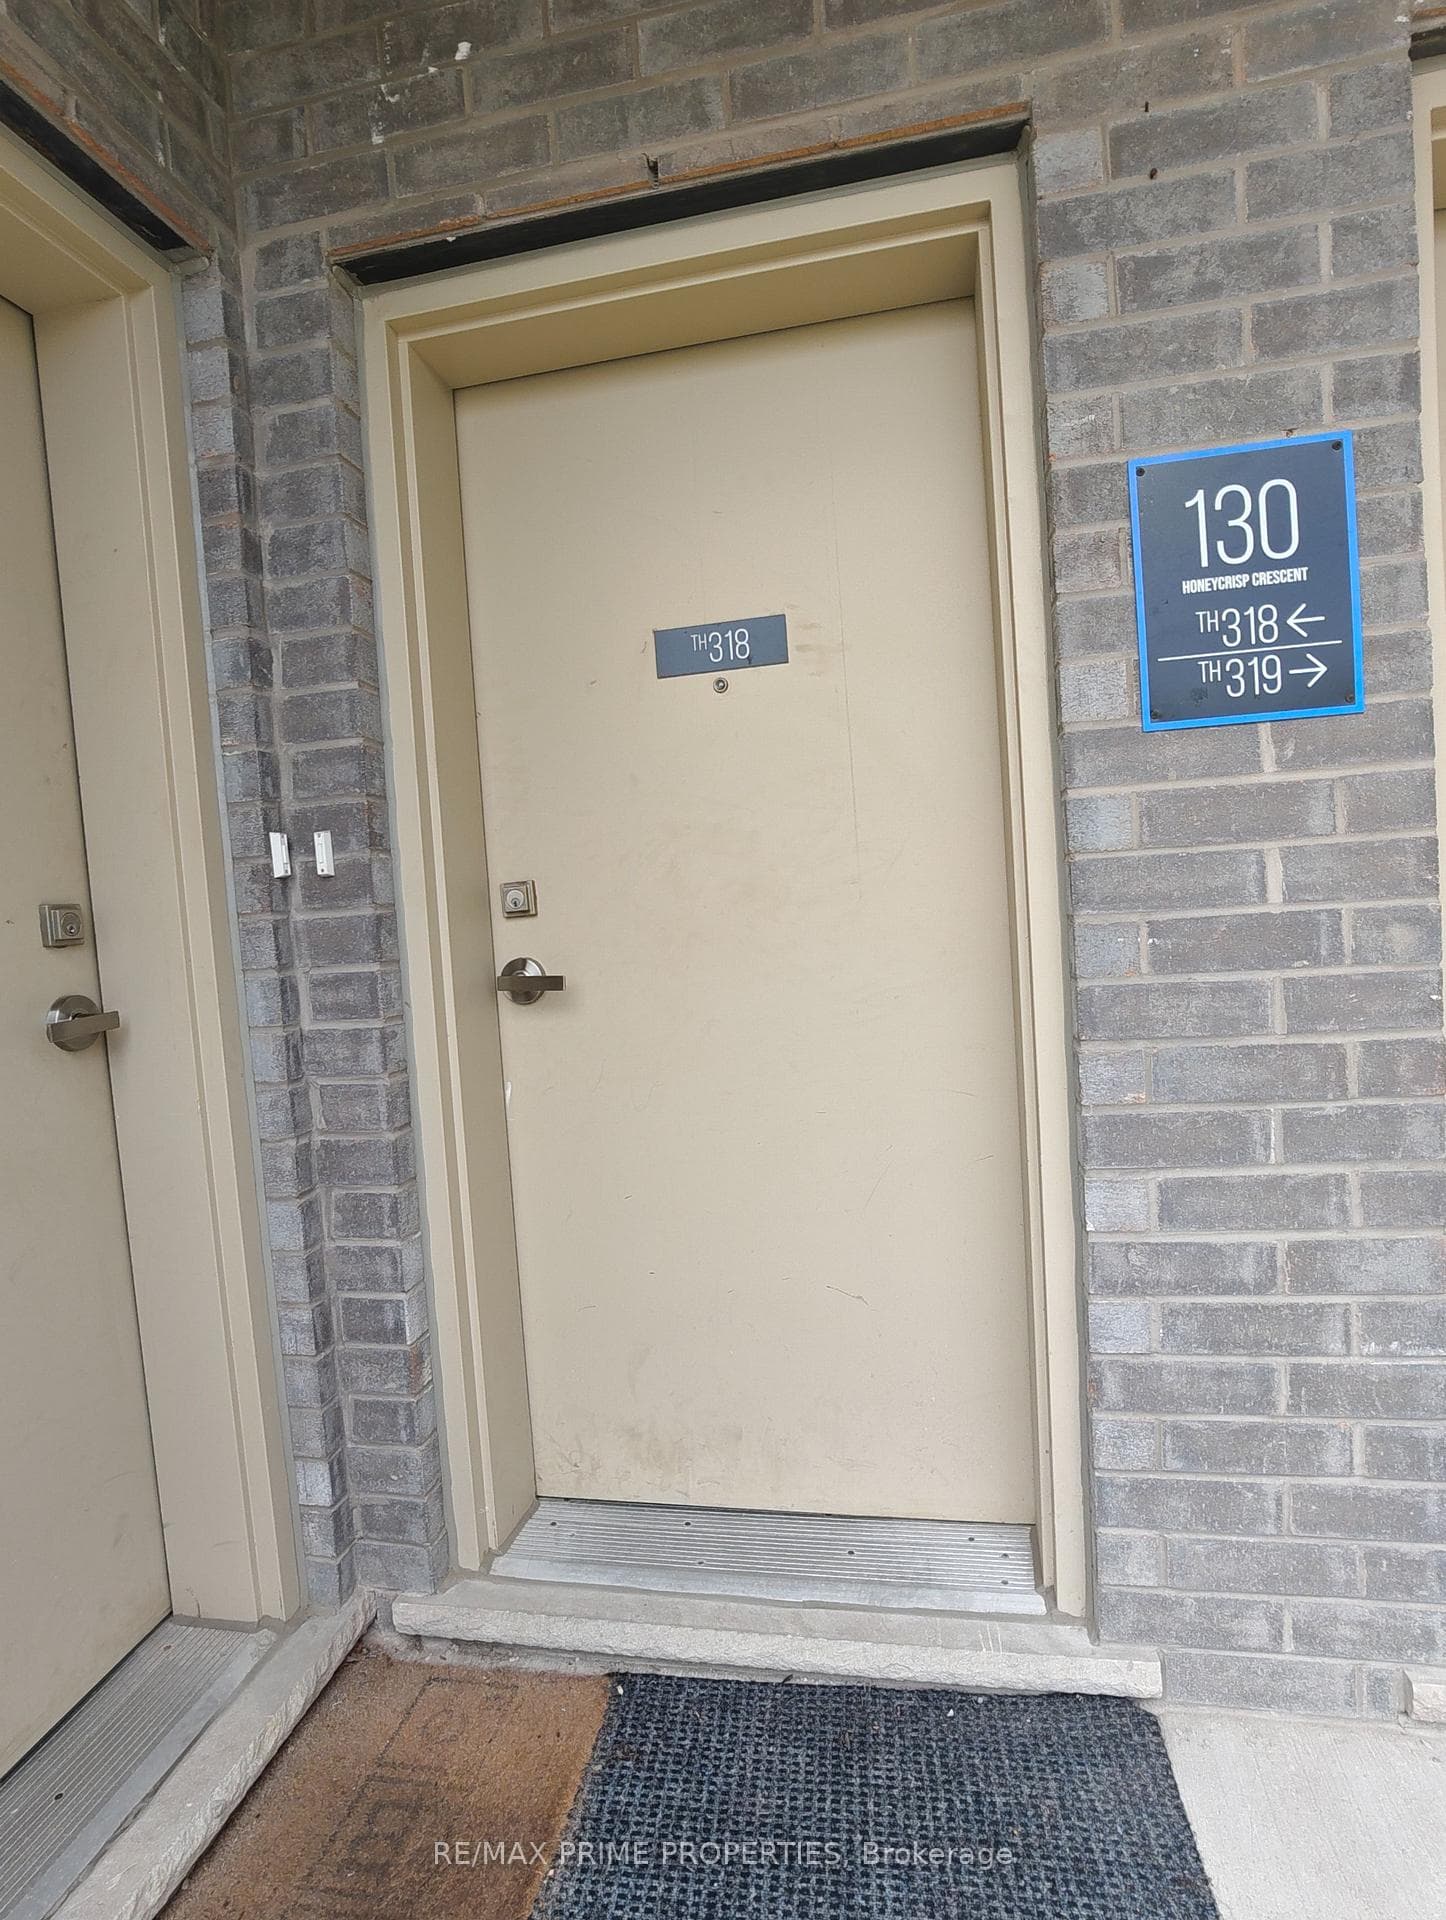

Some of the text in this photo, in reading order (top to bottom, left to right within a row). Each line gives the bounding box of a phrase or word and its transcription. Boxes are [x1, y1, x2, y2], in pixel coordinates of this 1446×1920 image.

[1184, 478, 1300, 568] 130
[1182, 567, 1309, 595] HONEYCRISP CRESCENT
[690, 628, 750, 663] TH318
[1195, 604, 1279, 648] TH318
[1198, 654, 1282, 698] TH319
